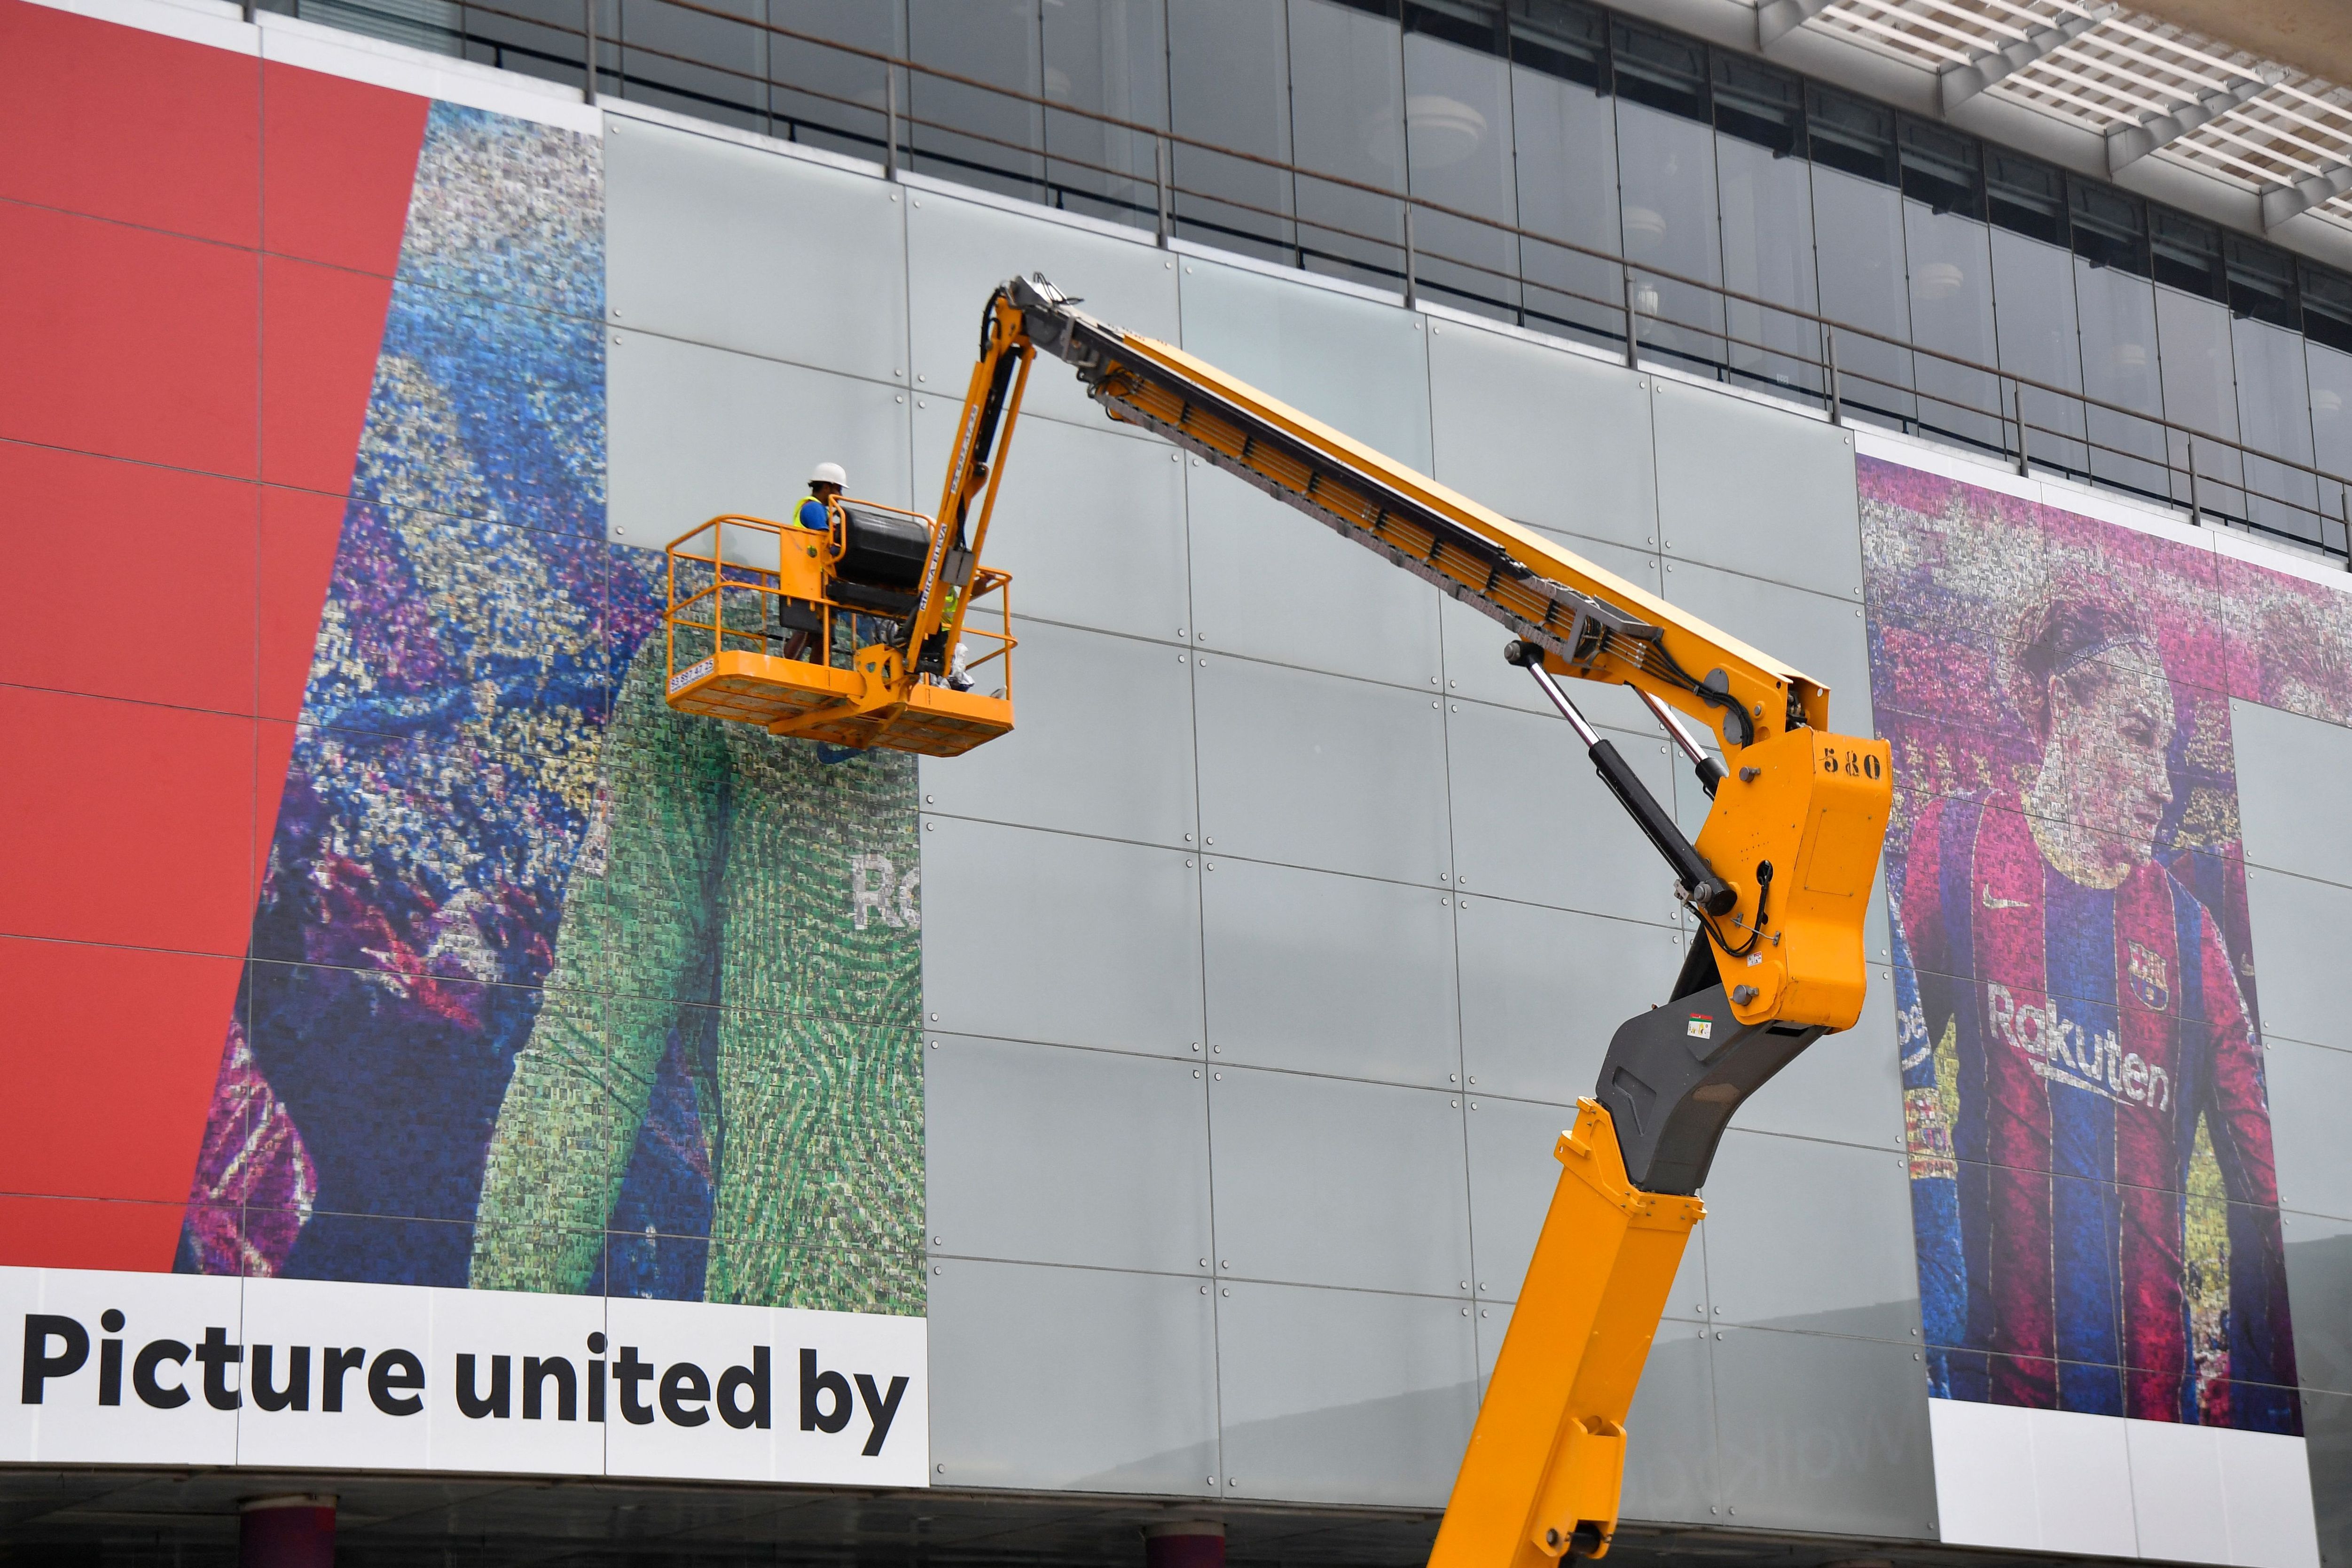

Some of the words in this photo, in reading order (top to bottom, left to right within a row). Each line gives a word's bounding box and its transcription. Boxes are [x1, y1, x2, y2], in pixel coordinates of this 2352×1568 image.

[672, 677, 679, 686] 93
[681, 670, 693, 683] 897
[695, 664, 703, 674] 47
[705, 659, 713, 670] 25
[1824, 747, 1880, 780] 580
[1987, 979, 2169, 1113] Rakuten
[22, 1308, 426, 1417] Picture
[455, 1331, 772, 1429] united
[799, 1348, 910, 1457] by
